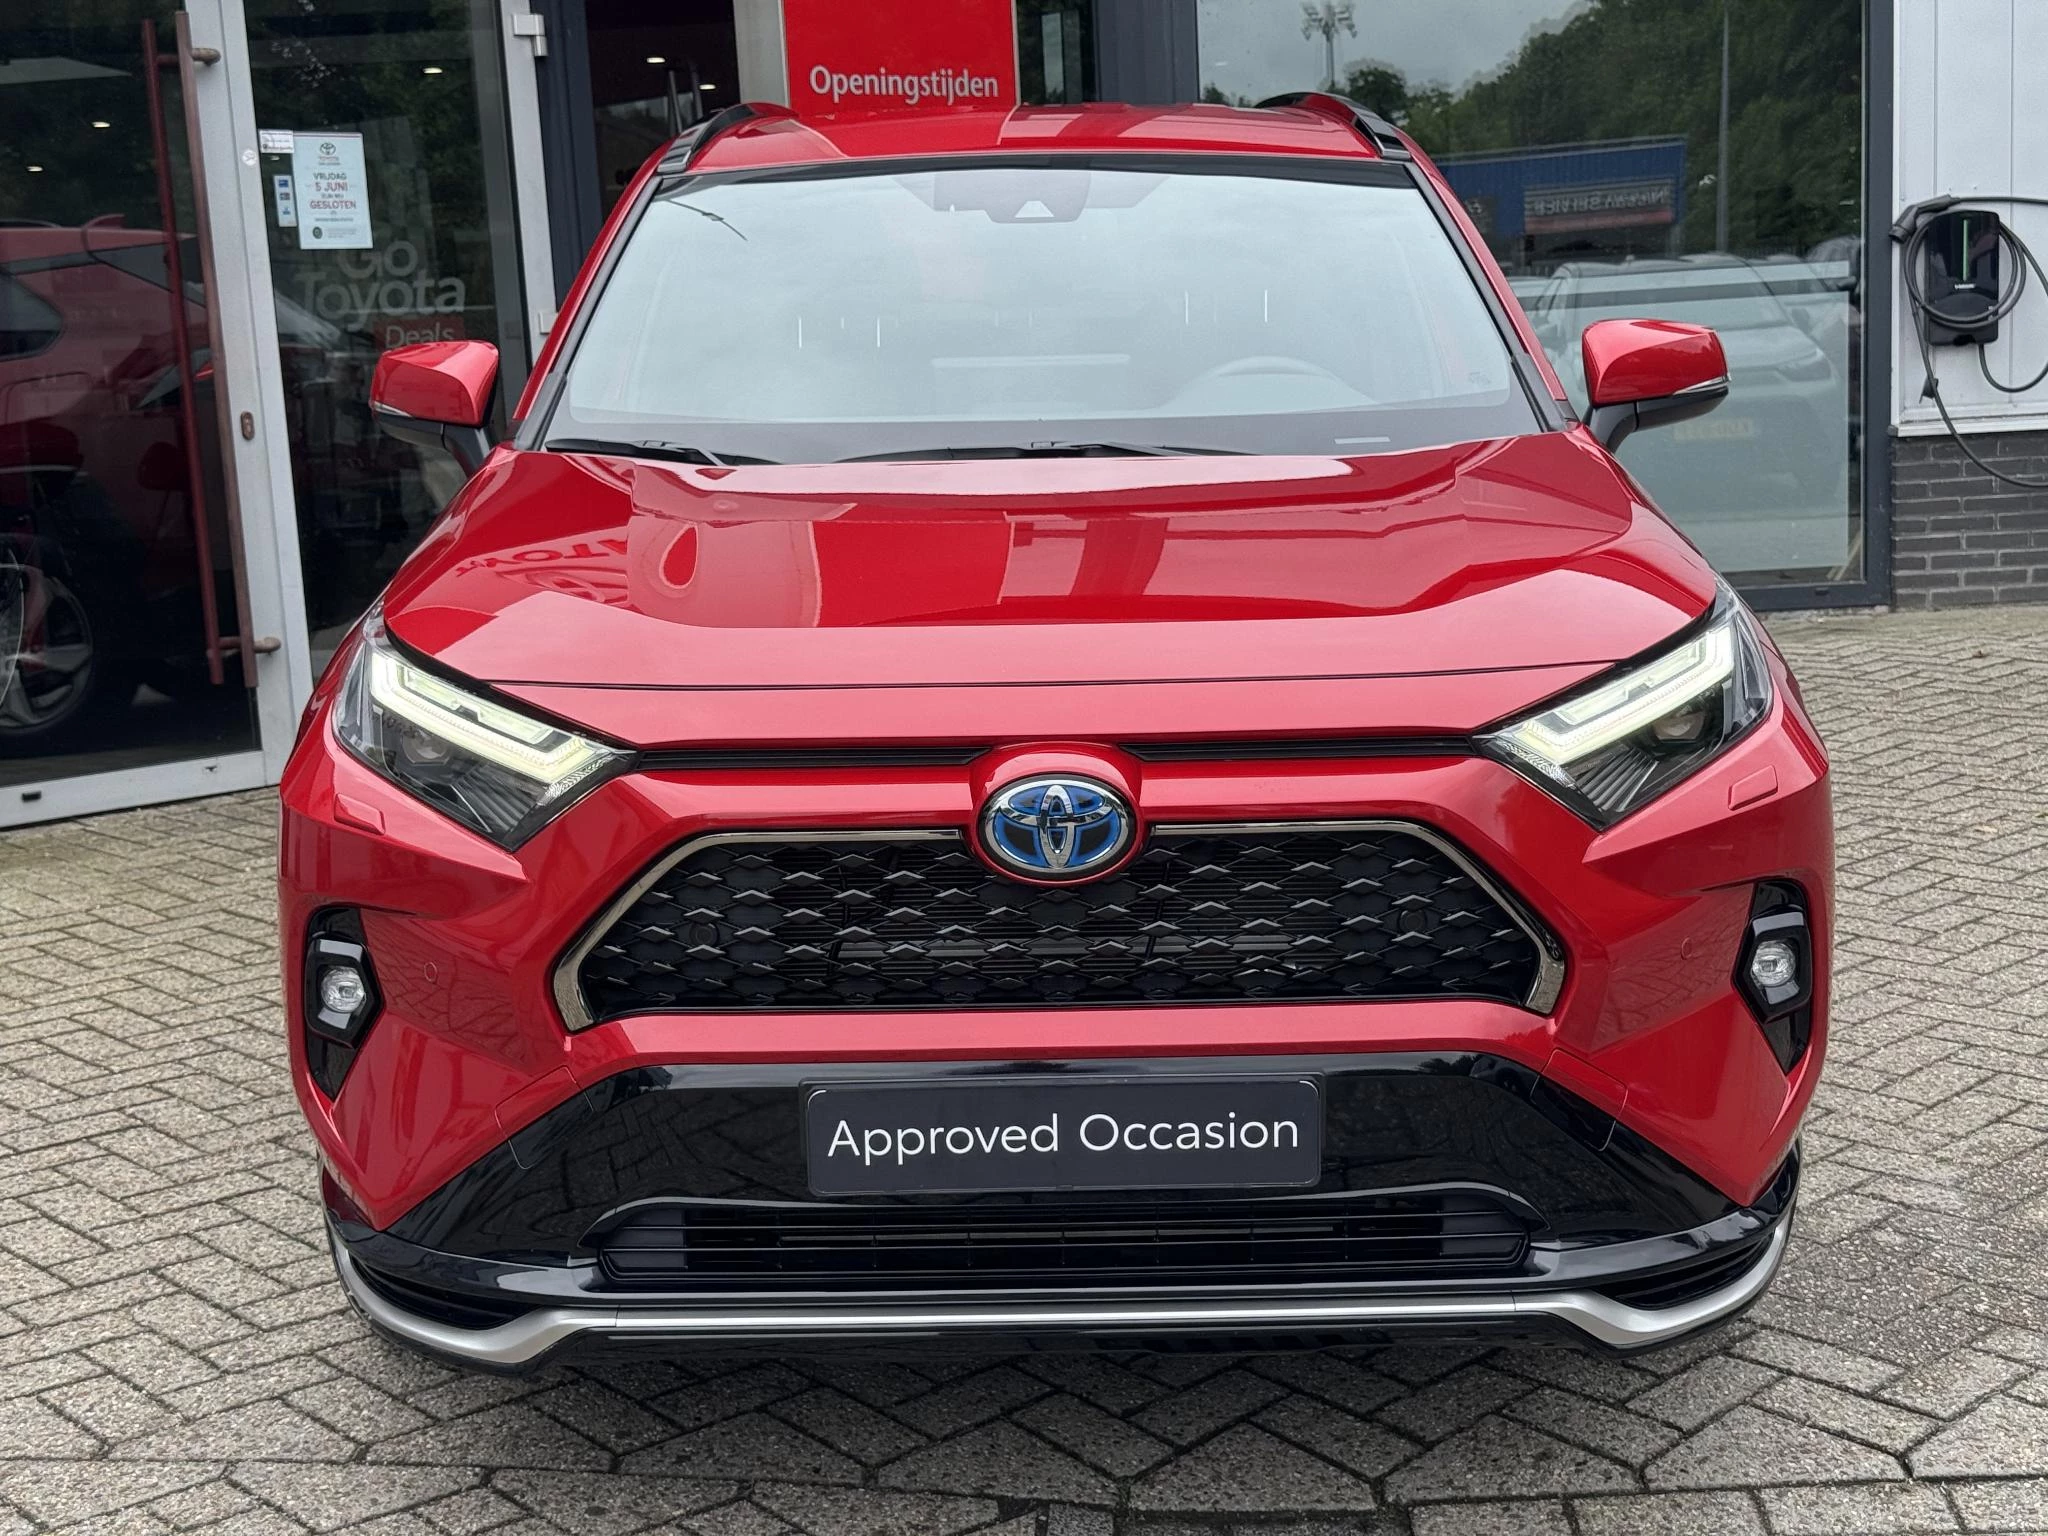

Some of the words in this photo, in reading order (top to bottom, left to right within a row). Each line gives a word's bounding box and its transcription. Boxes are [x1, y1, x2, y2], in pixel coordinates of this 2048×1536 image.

[809, 64, 999, 105] Openingstijden
[310, 200, 357, 210] GESLOTEN
[315, 182, 322, 192] 5
[324, 181, 349, 192] JUNI
[336, 239, 419, 279] Go
[295, 268, 467, 332] Toyota
[385, 321, 455, 349] Deals
[827, 1112, 1060, 1166] Approved
[1079, 1111, 1299, 1152] Occasion
